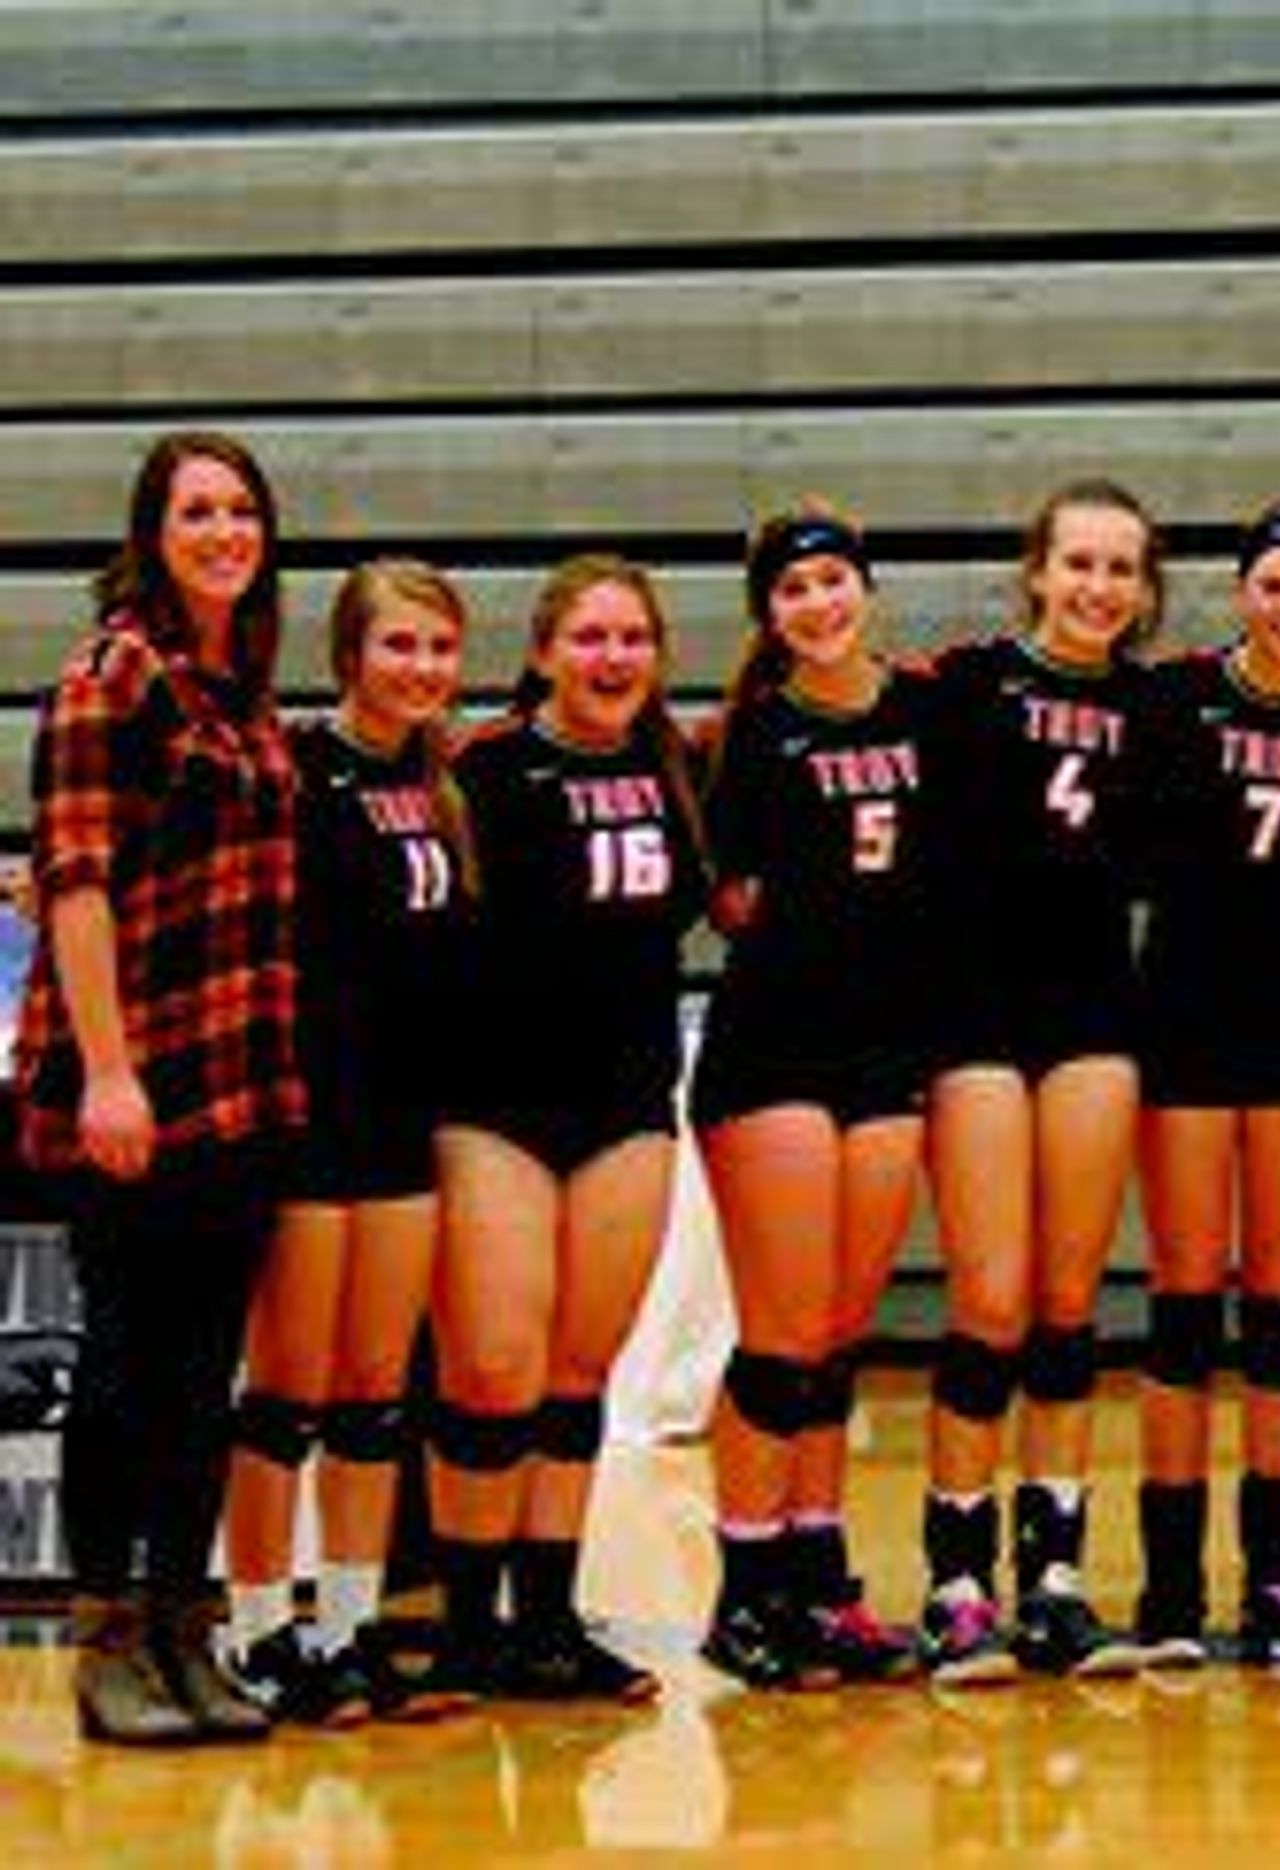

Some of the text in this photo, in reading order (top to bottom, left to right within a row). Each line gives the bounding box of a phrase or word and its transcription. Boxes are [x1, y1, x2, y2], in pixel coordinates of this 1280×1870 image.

[1022, 695, 1126, 756] TROY
[563, 775, 666, 824] TROY
[806, 743, 918, 797] TROY
[1045, 753, 1095, 828] 4
[588, 827, 671, 899] 16
[852, 799, 900, 873] 5
[402, 837, 450, 911] 11
